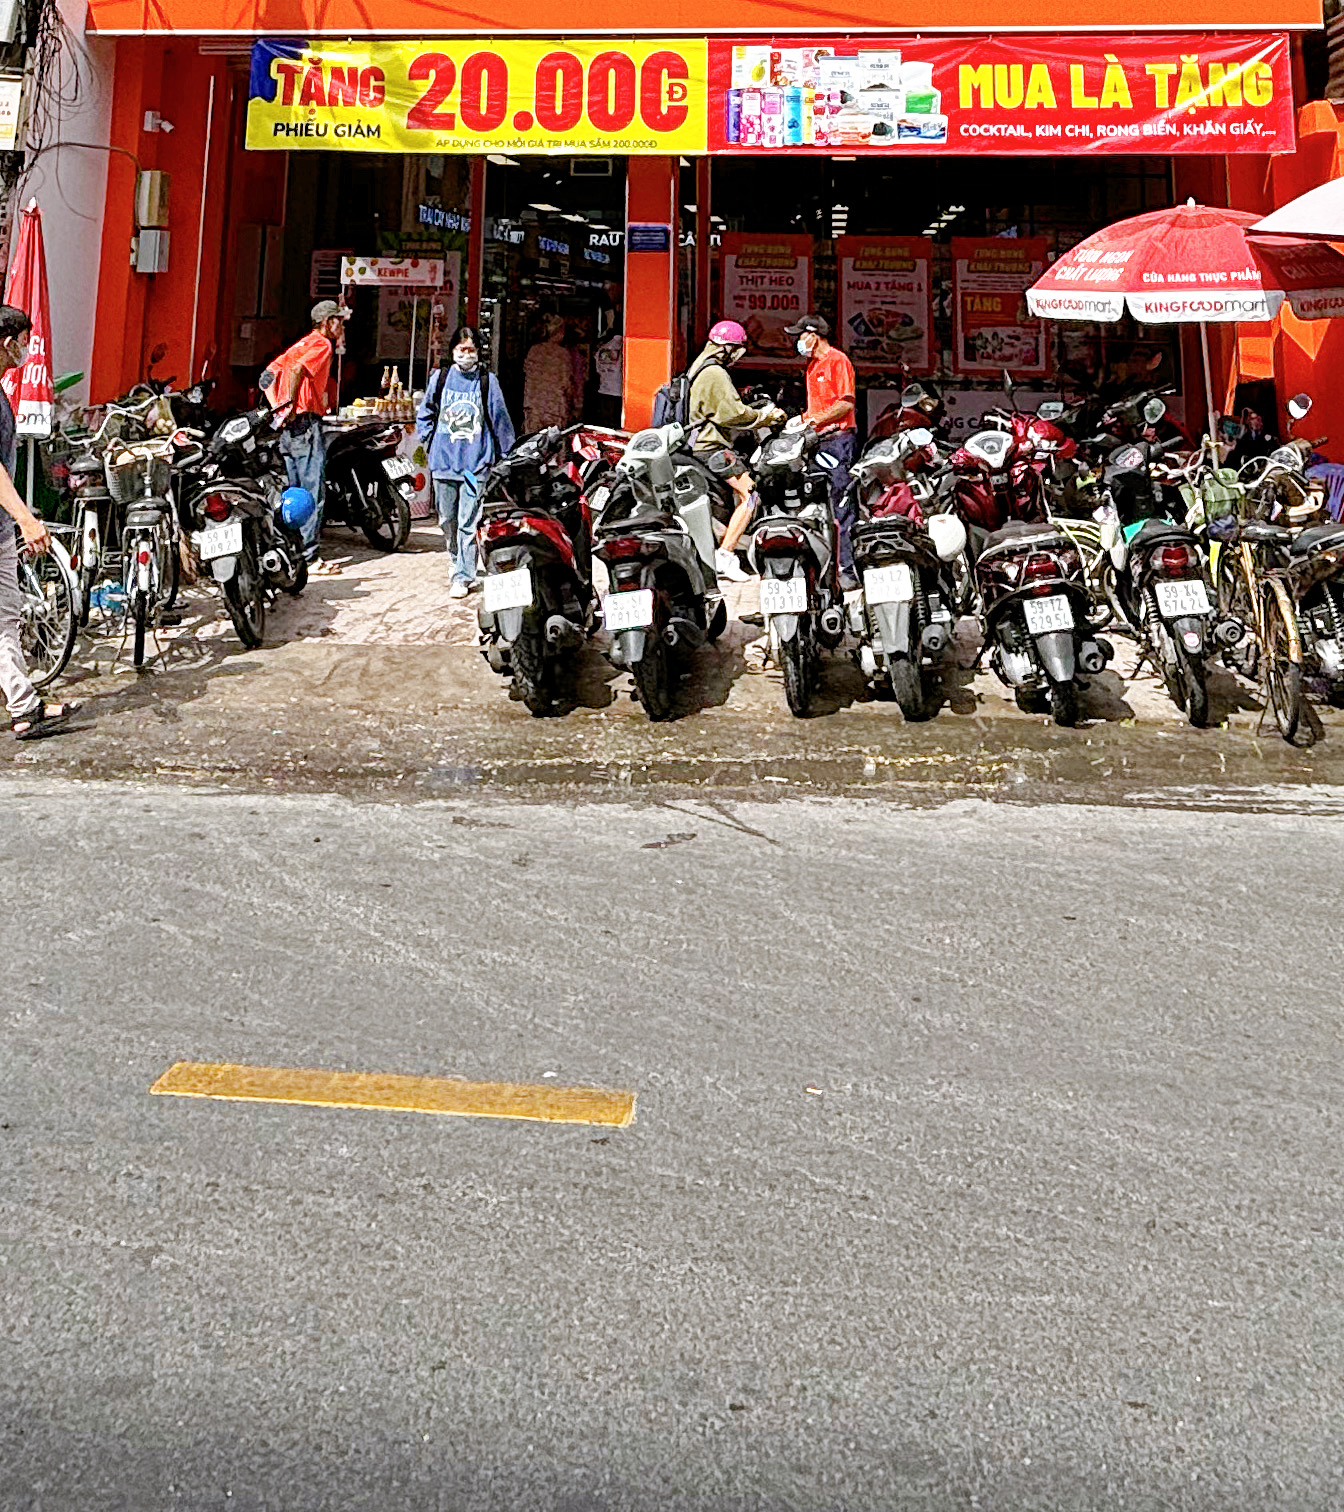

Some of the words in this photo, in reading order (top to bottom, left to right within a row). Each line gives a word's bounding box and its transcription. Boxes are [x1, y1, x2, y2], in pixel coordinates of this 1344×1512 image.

[269, 57, 387, 116] TẶNG
[958, 64, 1058, 109] MUA
[1070, 53, 1134, 109] LÀ
[1145, 53, 1274, 115] TẶNG
[333, 118, 382, 140] GIẢM
[1035, 124, 1062, 137] KIM
[1064, 124, 1094, 139] CHI,
[1097, 123, 1139, 137] RONG
[1183, 119, 1227, 137] KHĂN
[769, 275, 795, 287] HEO
